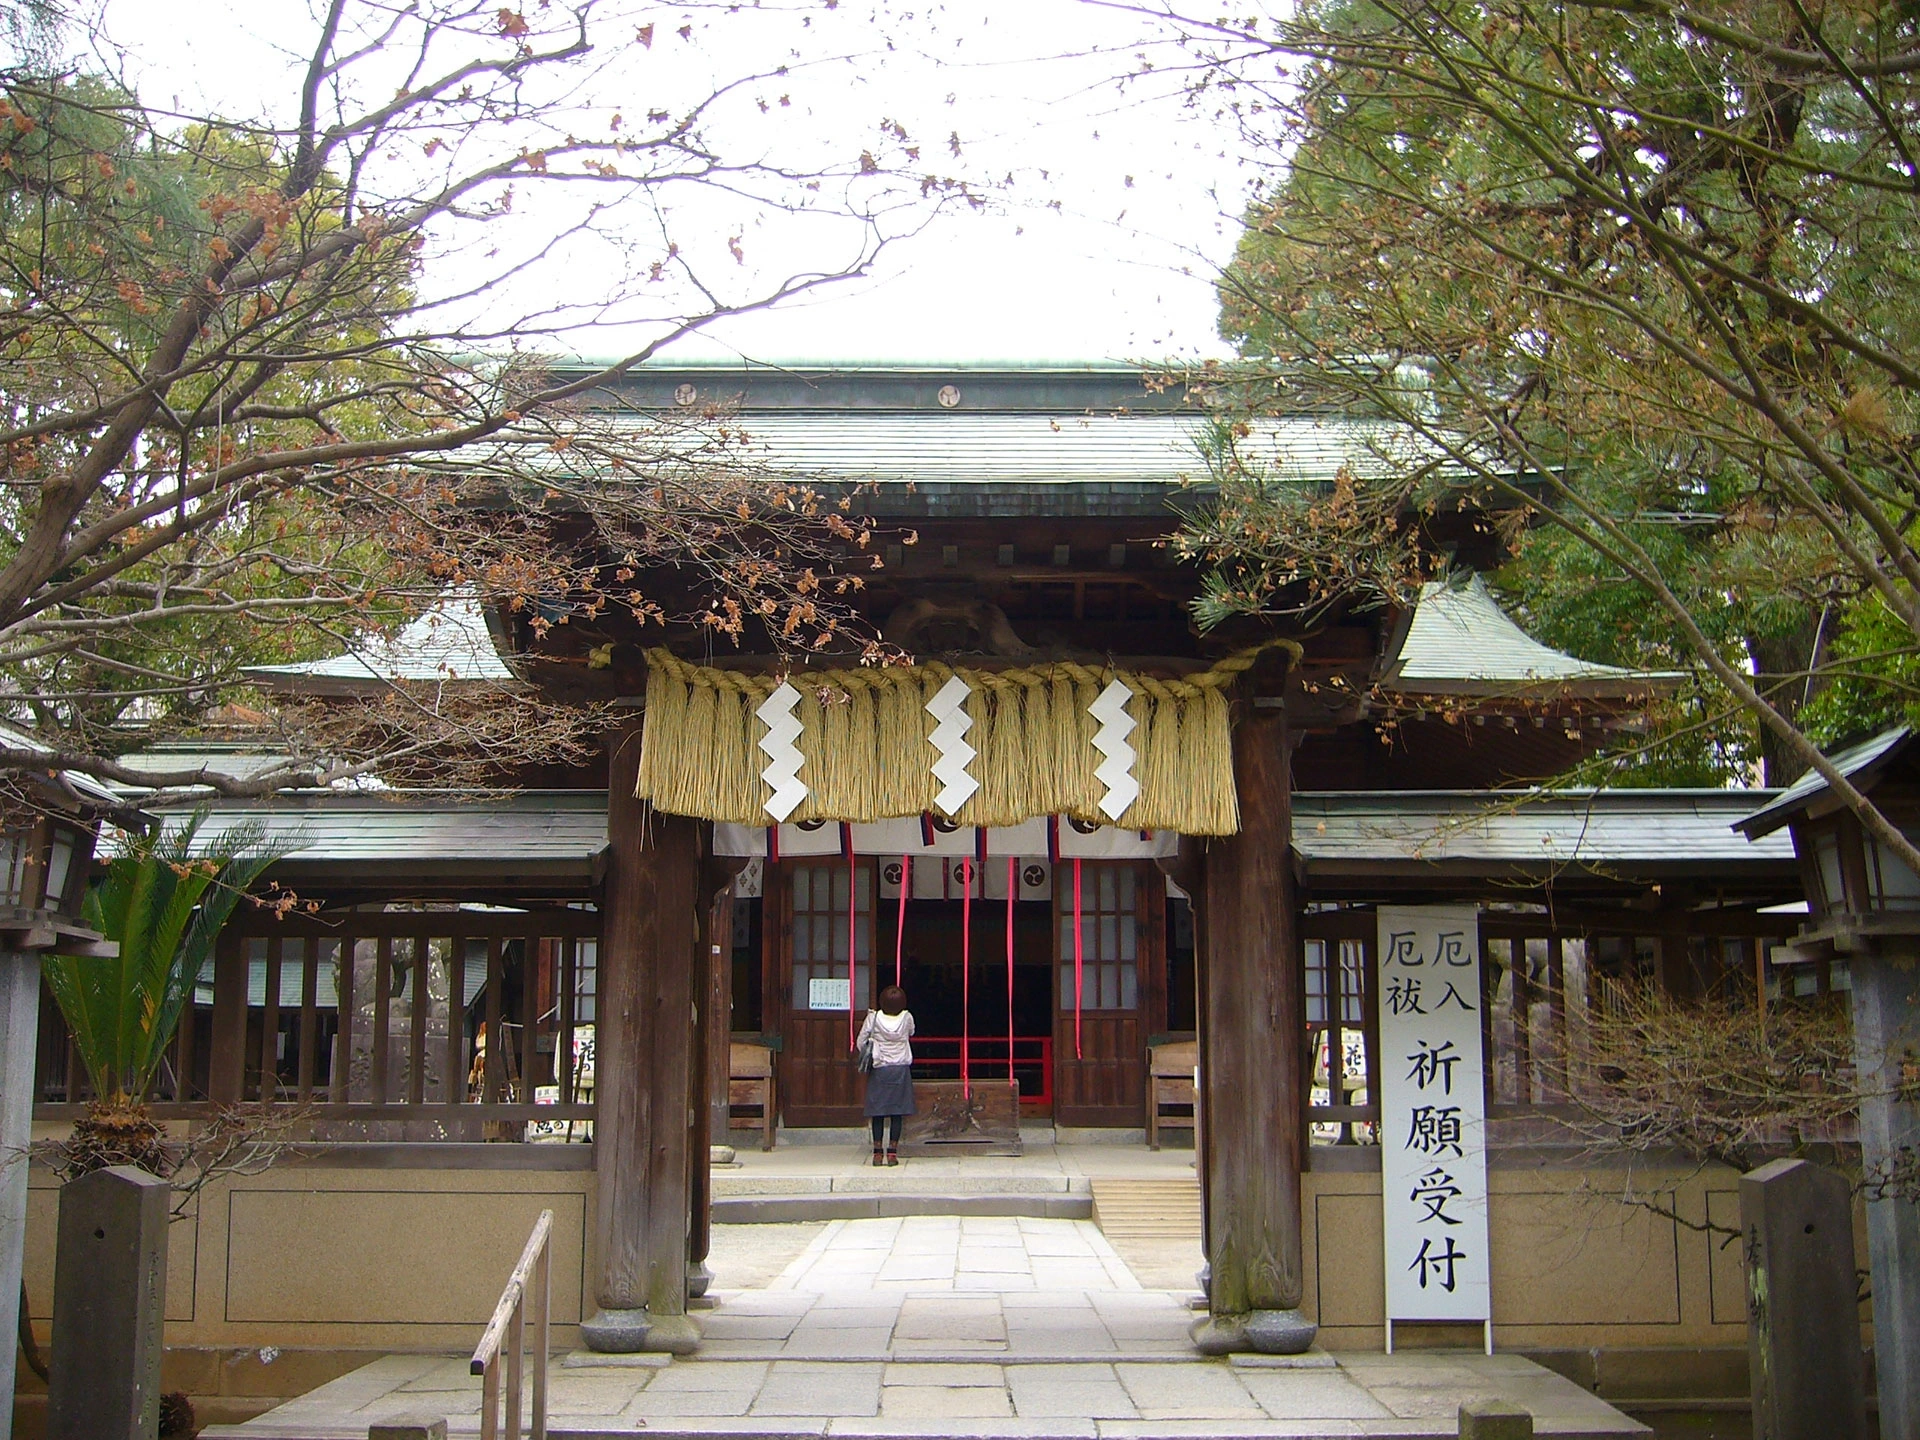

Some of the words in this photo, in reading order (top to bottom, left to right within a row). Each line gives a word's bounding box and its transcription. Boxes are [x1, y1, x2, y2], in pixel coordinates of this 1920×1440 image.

[1383, 931, 1428, 1015] 厄祓
[1432, 931, 1476, 1011] 厄入
[1404, 1040, 1466, 1293] 祈願受付
